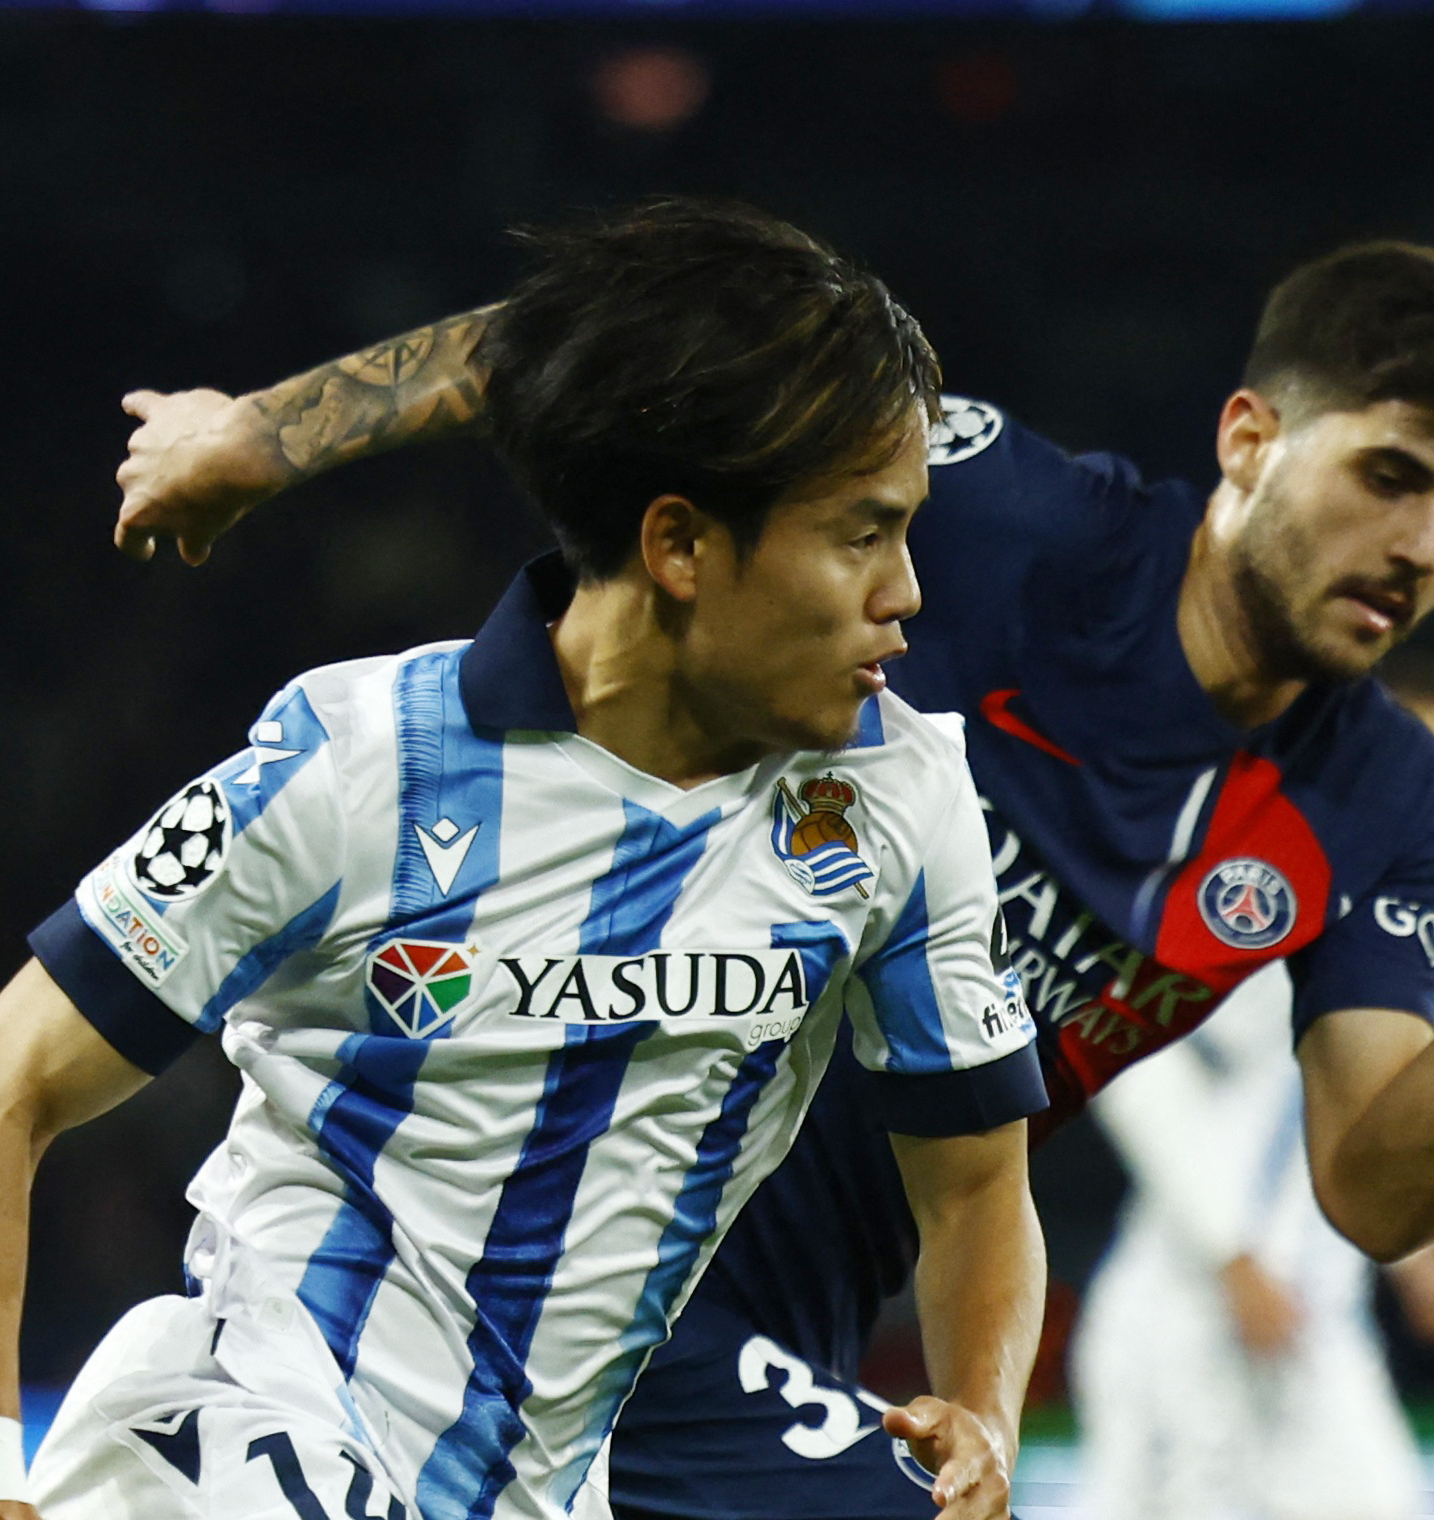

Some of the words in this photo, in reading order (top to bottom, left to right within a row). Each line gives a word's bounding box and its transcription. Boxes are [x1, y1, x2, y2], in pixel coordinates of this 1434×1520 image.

[1218, 862, 1284, 897] PARIS
[497, 950, 807, 1021] YASUDA
[747, 1014, 802, 1049] group
